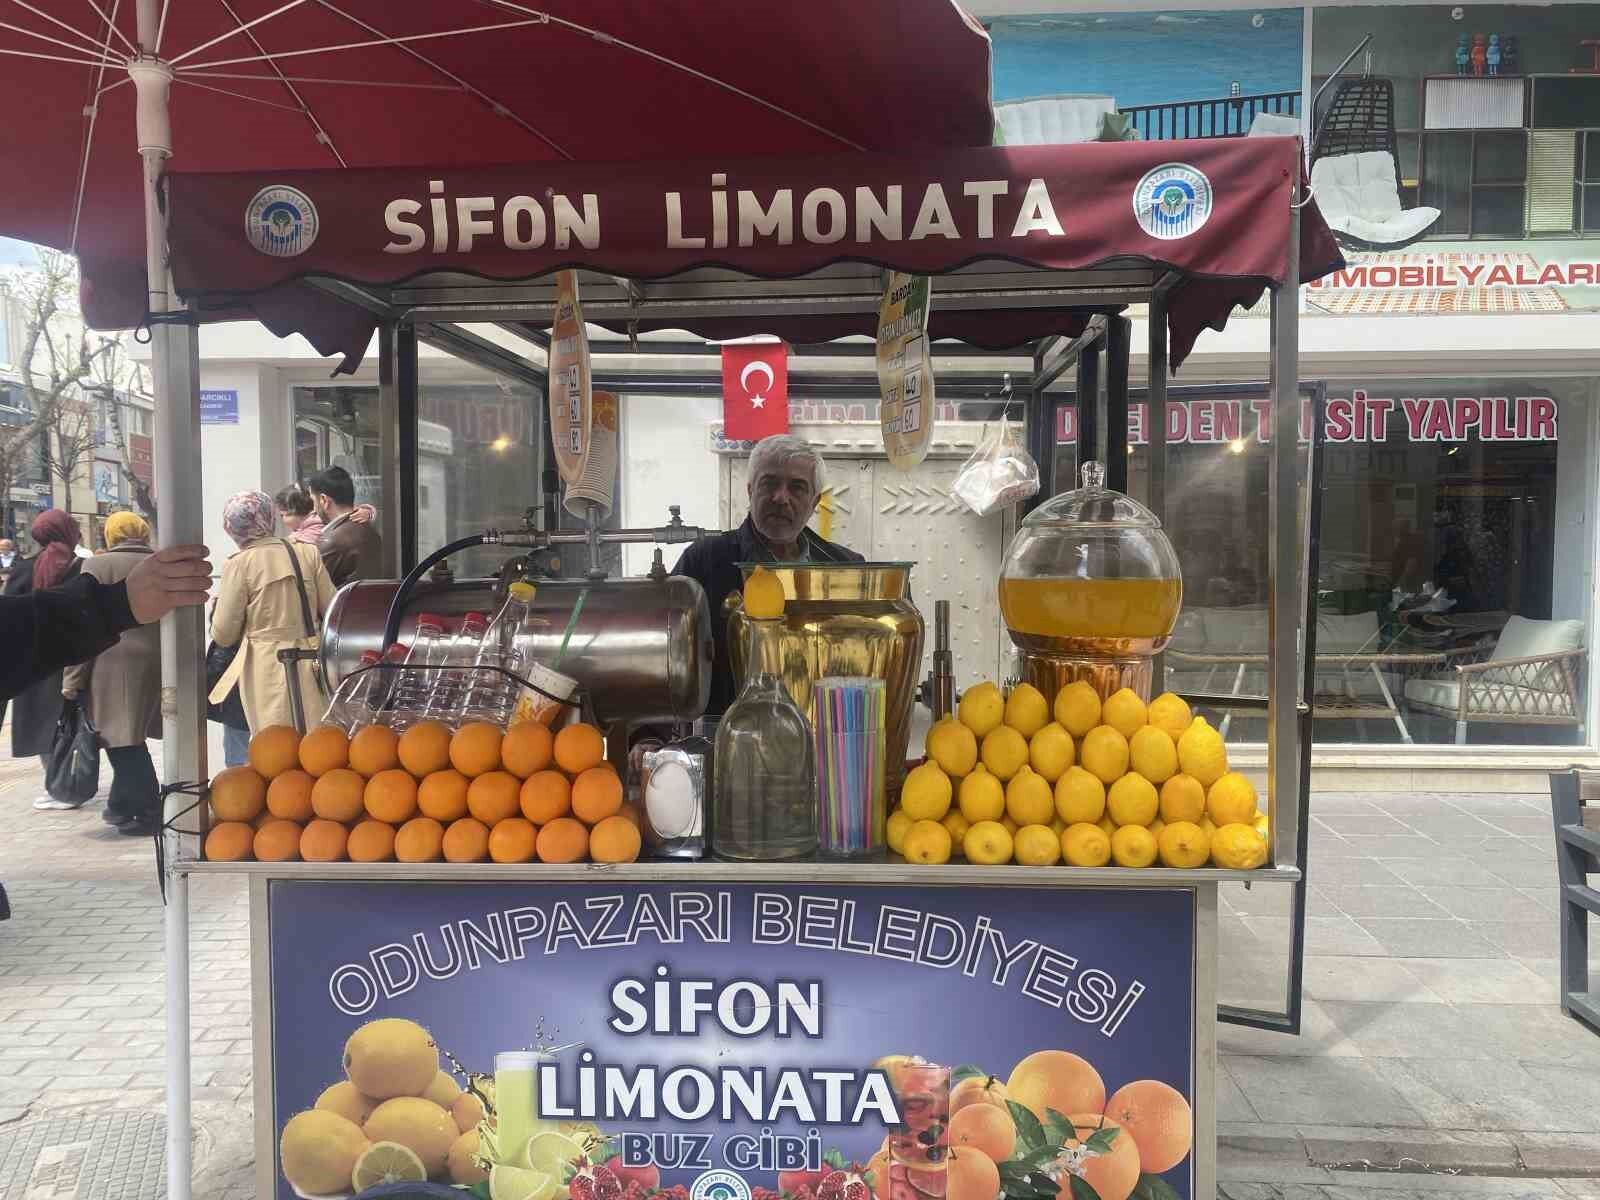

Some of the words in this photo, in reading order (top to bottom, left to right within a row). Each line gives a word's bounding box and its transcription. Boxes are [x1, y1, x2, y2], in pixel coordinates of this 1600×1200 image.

[383, 179, 602, 255] SİFON
[665, 172, 1065, 250] LİMONATA
[1251, 389, 1395, 443] TSİT
[1403, 396, 1558, 441] YAPILIR
[328, 890, 732, 1018] ODUNPAZARI
[752, 891, 1146, 1038] BELEDİYESİ
[608, 963, 823, 1038] SİFON
[538, 1052, 902, 1127] LİMONATA
[621, 1132, 714, 1169] BUZ
[722, 1128, 823, 1172] GİBİ
